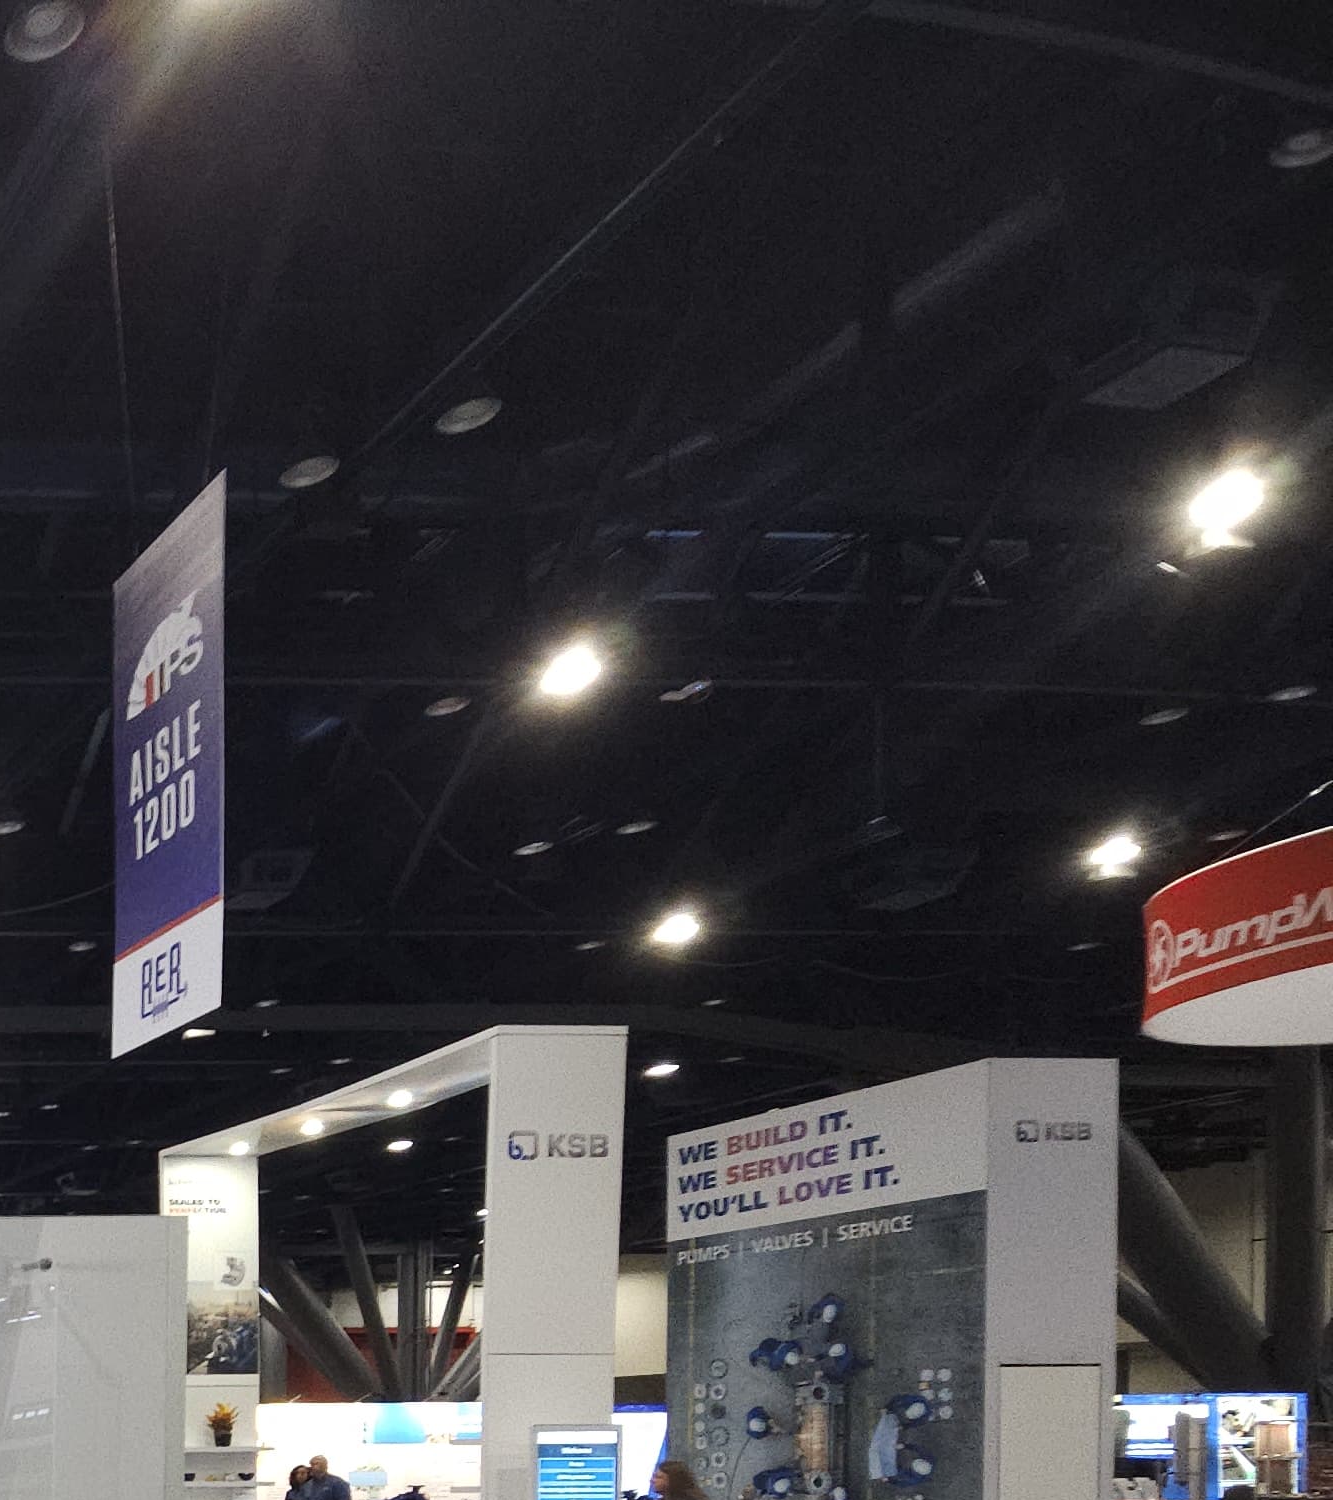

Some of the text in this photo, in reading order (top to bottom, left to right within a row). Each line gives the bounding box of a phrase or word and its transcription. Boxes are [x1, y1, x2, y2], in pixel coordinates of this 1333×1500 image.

[129, 699, 201, 806] AISLE
[134, 769, 195, 860] 1200
[548, 1133, 609, 1158] KSB
[678, 1135, 886, 1194] WE SERVICE IT.
[679, 1109, 853, 1165] WE BUILD IT.
[679, 1165, 900, 1223] YOU'LL LOVE IT.
[676, 1214, 914, 1265] PUMPS VALVES SERVICE
